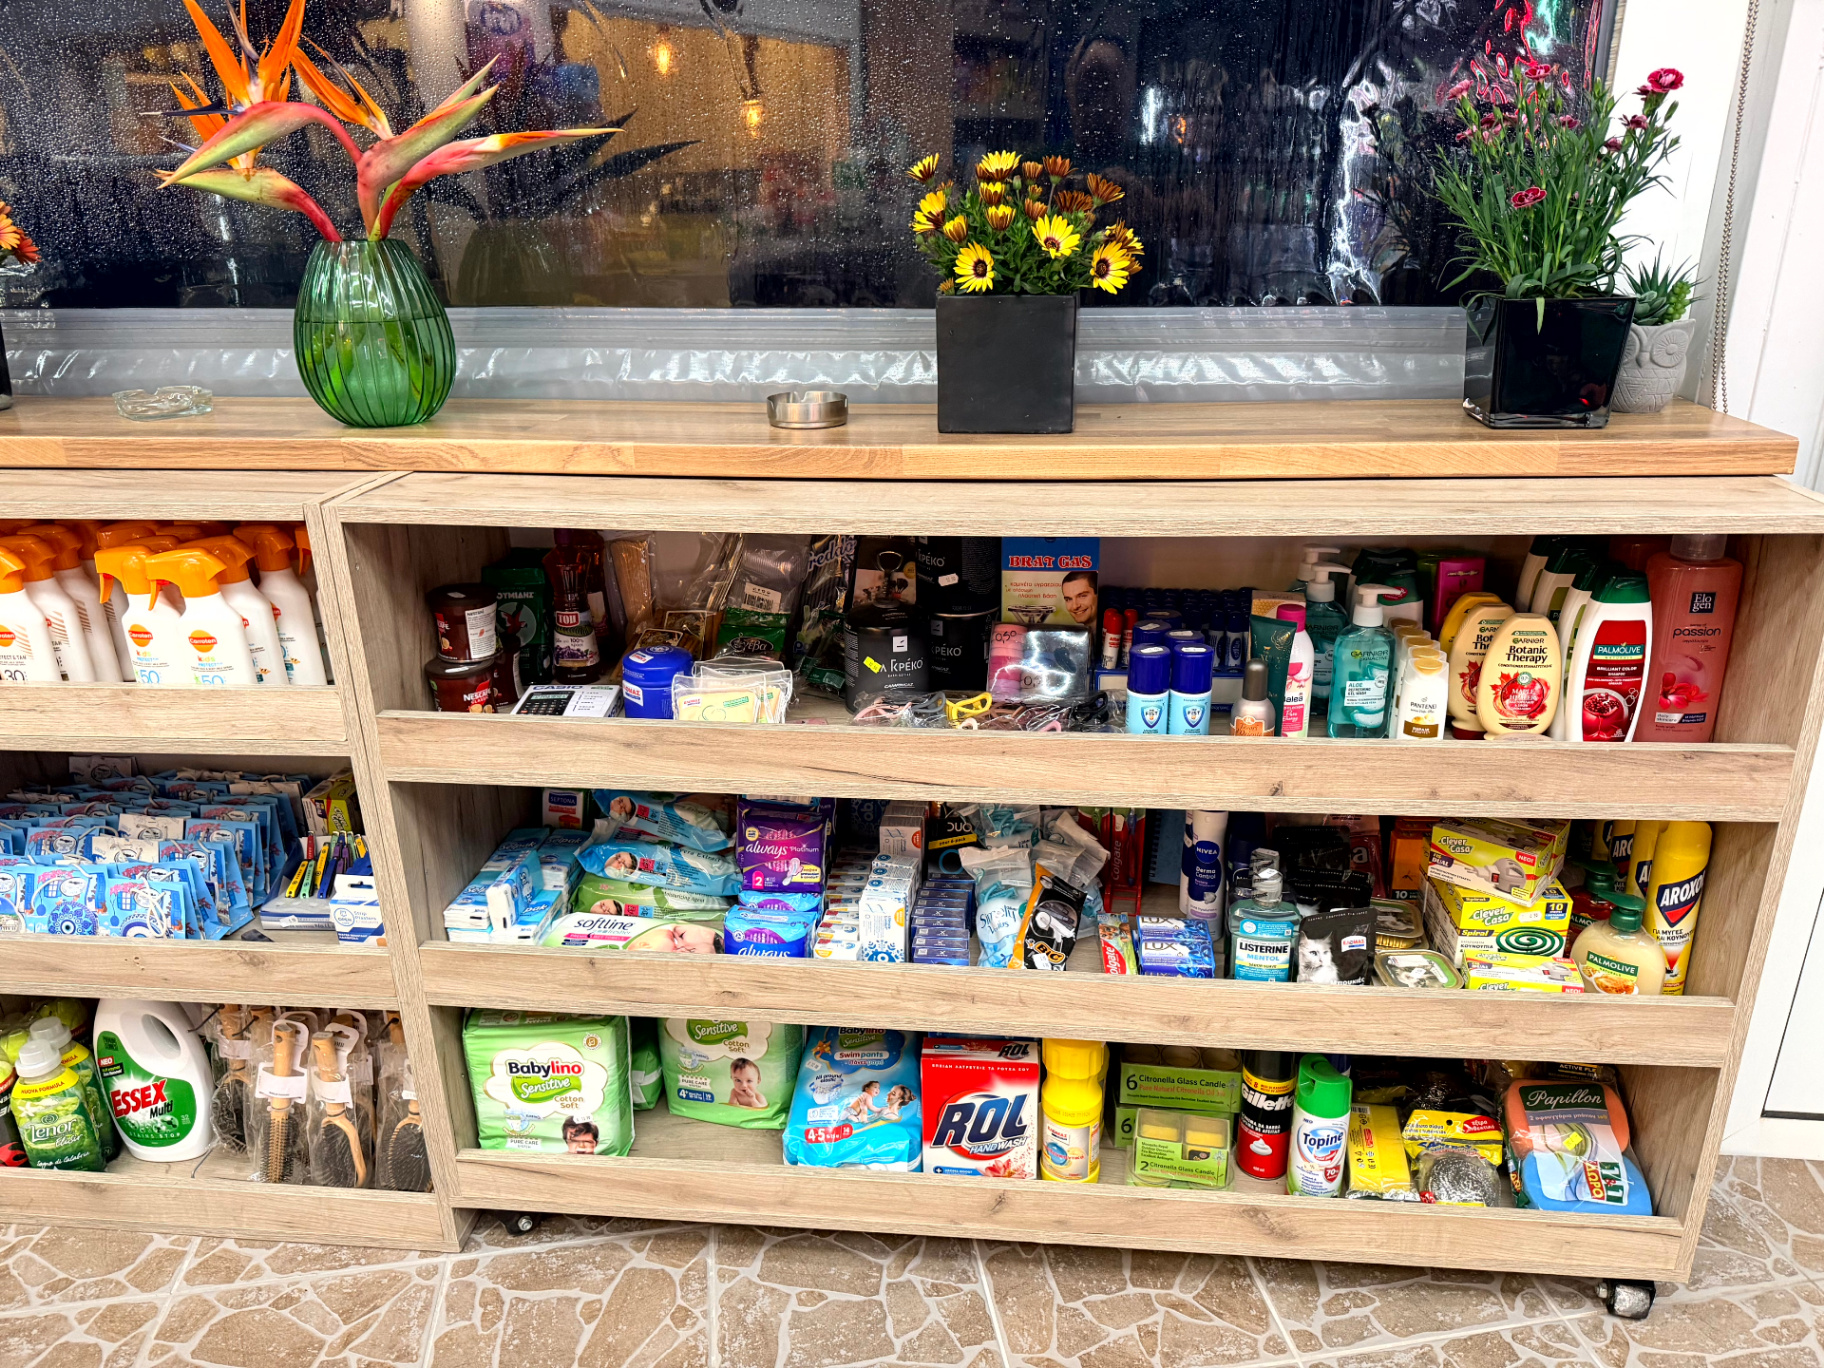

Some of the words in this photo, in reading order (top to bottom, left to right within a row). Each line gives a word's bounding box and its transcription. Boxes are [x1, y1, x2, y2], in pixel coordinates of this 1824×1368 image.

[1009, 555, 1055, 568] BRAT
[1058, 556, 1093, 569] GAS
[497, 591, 534, 600] ΟΥΜΙΔΗΣ
[1694, 593, 1712, 602] Elo
[1691, 602, 1712, 612] gen
[1476, 634, 1493, 643] Bot
[1673, 627, 1721, 639] passion
[1472, 641, 1490, 650] The
[1512, 637, 1545, 645] GARNIER
[1351, 650, 1389, 659] GARNIER
[1509, 646, 1548, 655] Botanic
[1597, 646, 1641, 654] PALMOLIVE
[1506, 653, 1548, 664] Therapy
[140, 669, 159, 683] 50
[201, 674, 224, 684] 50
[1285, 695, 1304, 703] alea
[1440, 836, 1467, 845] Clever
[745, 841, 788, 859] always
[1196, 847, 1218, 855] NIVEA
[1450, 845, 1471, 853] Casa
[1112, 840, 1122, 881] Colgate
[755, 876, 763, 887] 2
[1395, 890, 1408, 900] 10
[1549, 903, 1564, 911] 10
[1473, 907, 1505, 919] Clever
[574, 917, 634, 931] softline
[1484, 914, 1510, 926] Casa
[1144, 942, 1178, 951] LUX
[1240, 942, 1288, 954] LISTERINE
[1107, 945, 1119, 975] olgate
[1588, 954, 1636, 975] PALMOLIVE
[694, 1022, 738, 1040] Sensitive
[839, 1027, 885, 1036] Babylino
[723, 1039, 750, 1048] Cotton
[860, 1051, 884, 1059] pants
[997, 1043, 1030, 1057] ROL
[100, 1056, 113, 1066] NEO
[508, 1061, 582, 1078] Babylino
[1559, 1063, 1583, 1071] ACTIVE
[1126, 1074, 1138, 1090] 6
[1138, 1074, 1175, 1084] Citronella
[1176, 1077, 1198, 1086] Glass
[1199, 1079, 1226, 1089] Candle
[1253, 1081, 1259, 1089] 8
[521, 1077, 571, 1099] Sensitive
[110, 1078, 168, 1118] ESSEX
[554, 1095, 584, 1103] Cotton
[1241, 1082, 1295, 1112] Gillette
[1526, 1088, 1602, 1110] Papillon
[150, 1099, 174, 1120] Multi
[560, 1102, 579, 1110] Soft
[930, 1093, 1030, 1148] ROL
[1121, 1117, 1132, 1134] 6
[31, 1118, 77, 1143] Lenor
[1303, 1131, 1344, 1149] Topine
[969, 1142, 999, 1155] HAND
[997, 1137, 1026, 1151] WASH
[1140, 1160, 1149, 1171] 2
[1149, 1161, 1177, 1171] Citronella
[1194, 1166, 1215, 1176] Candle
[1586, 1162, 1604, 1199] ΔΩΡΟ
